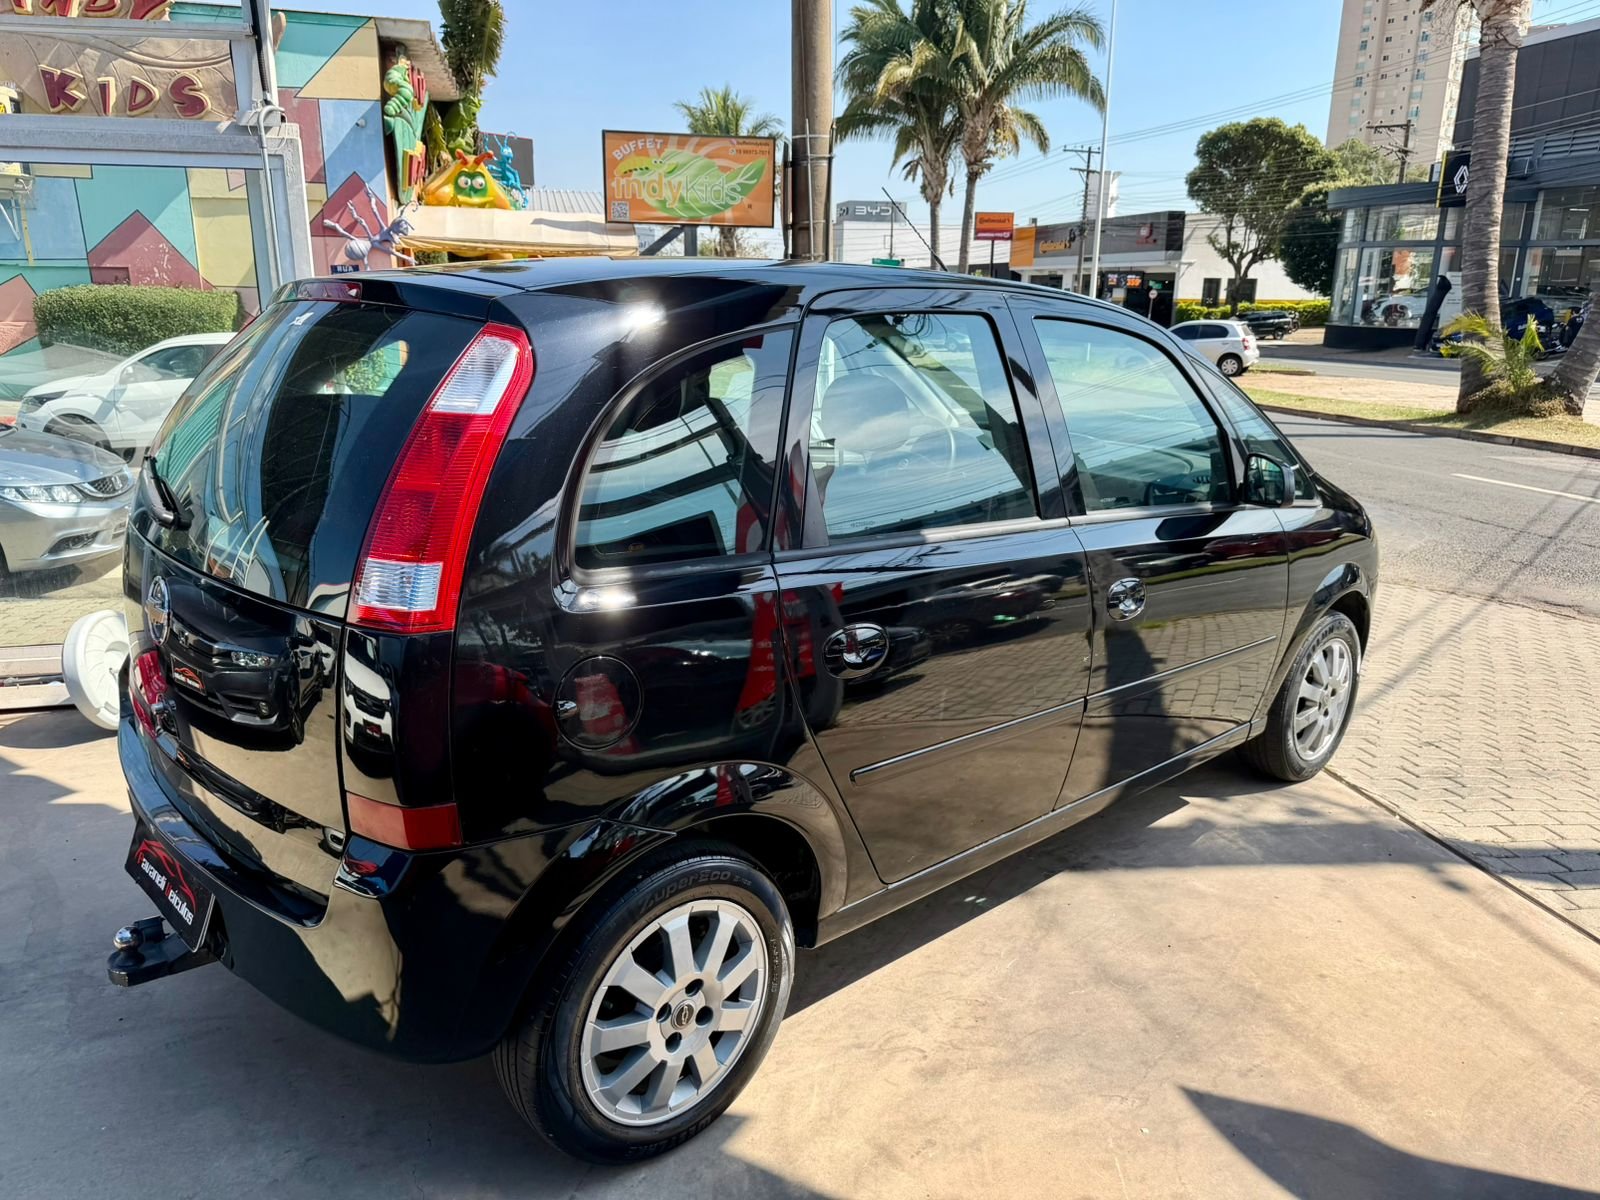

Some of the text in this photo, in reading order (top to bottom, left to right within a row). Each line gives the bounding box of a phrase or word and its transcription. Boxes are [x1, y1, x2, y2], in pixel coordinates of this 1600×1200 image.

[38, 64, 212, 119] KIDS
[612, 137, 664, 160] BUFFET
[613, 171, 743, 209] indyKids
[855, 205, 892, 216] BYD
[336, 265, 354, 273] RUA
